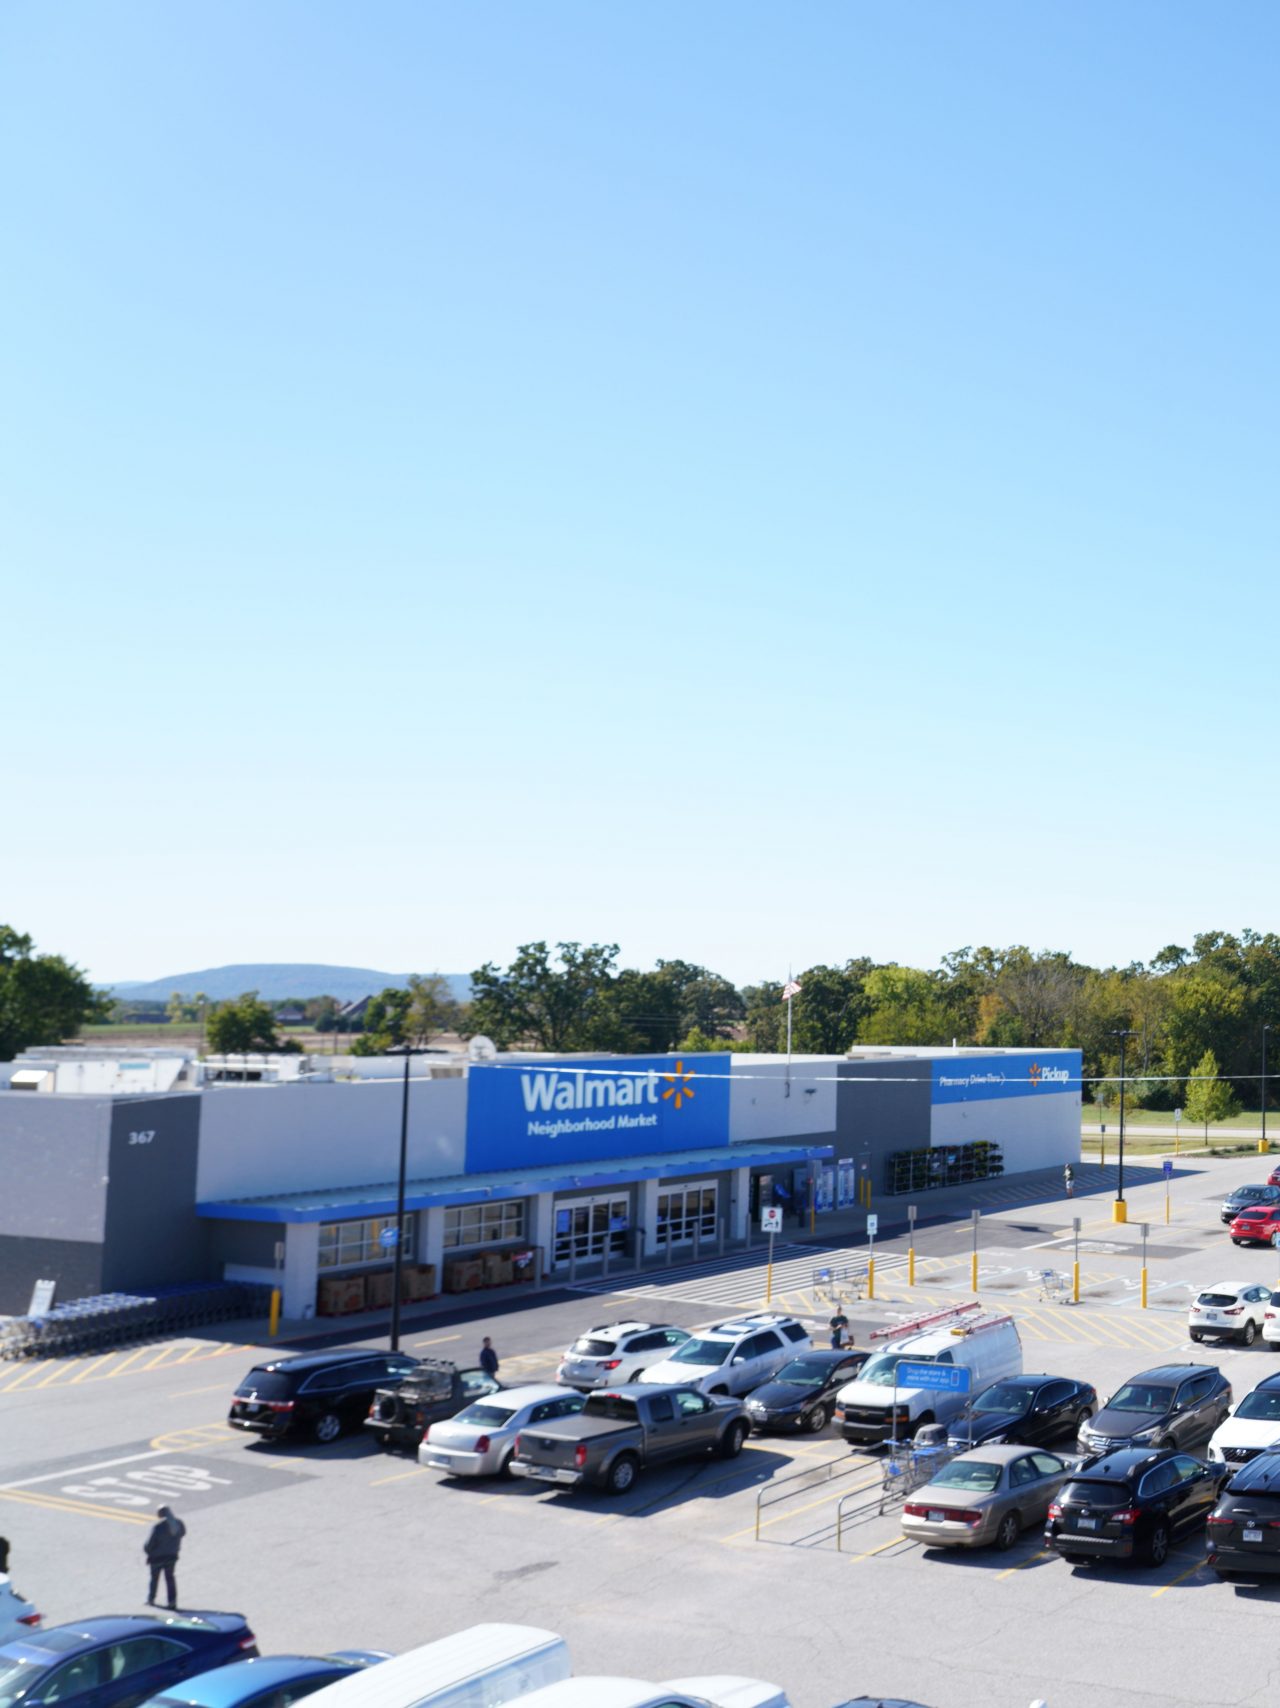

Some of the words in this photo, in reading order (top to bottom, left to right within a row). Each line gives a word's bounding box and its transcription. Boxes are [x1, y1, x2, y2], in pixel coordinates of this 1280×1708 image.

[939, 1076, 970, 1088] Pharmacy
[1041, 1066, 1069, 1085] Pickup
[520, 1069, 659, 1112] Walmart
[128, 1130, 156, 1145] 367
[527, 1116, 615, 1139] Neighborhood
[617, 1114, 658, 1129] Market
[61, 1465, 233, 1506] STOP
